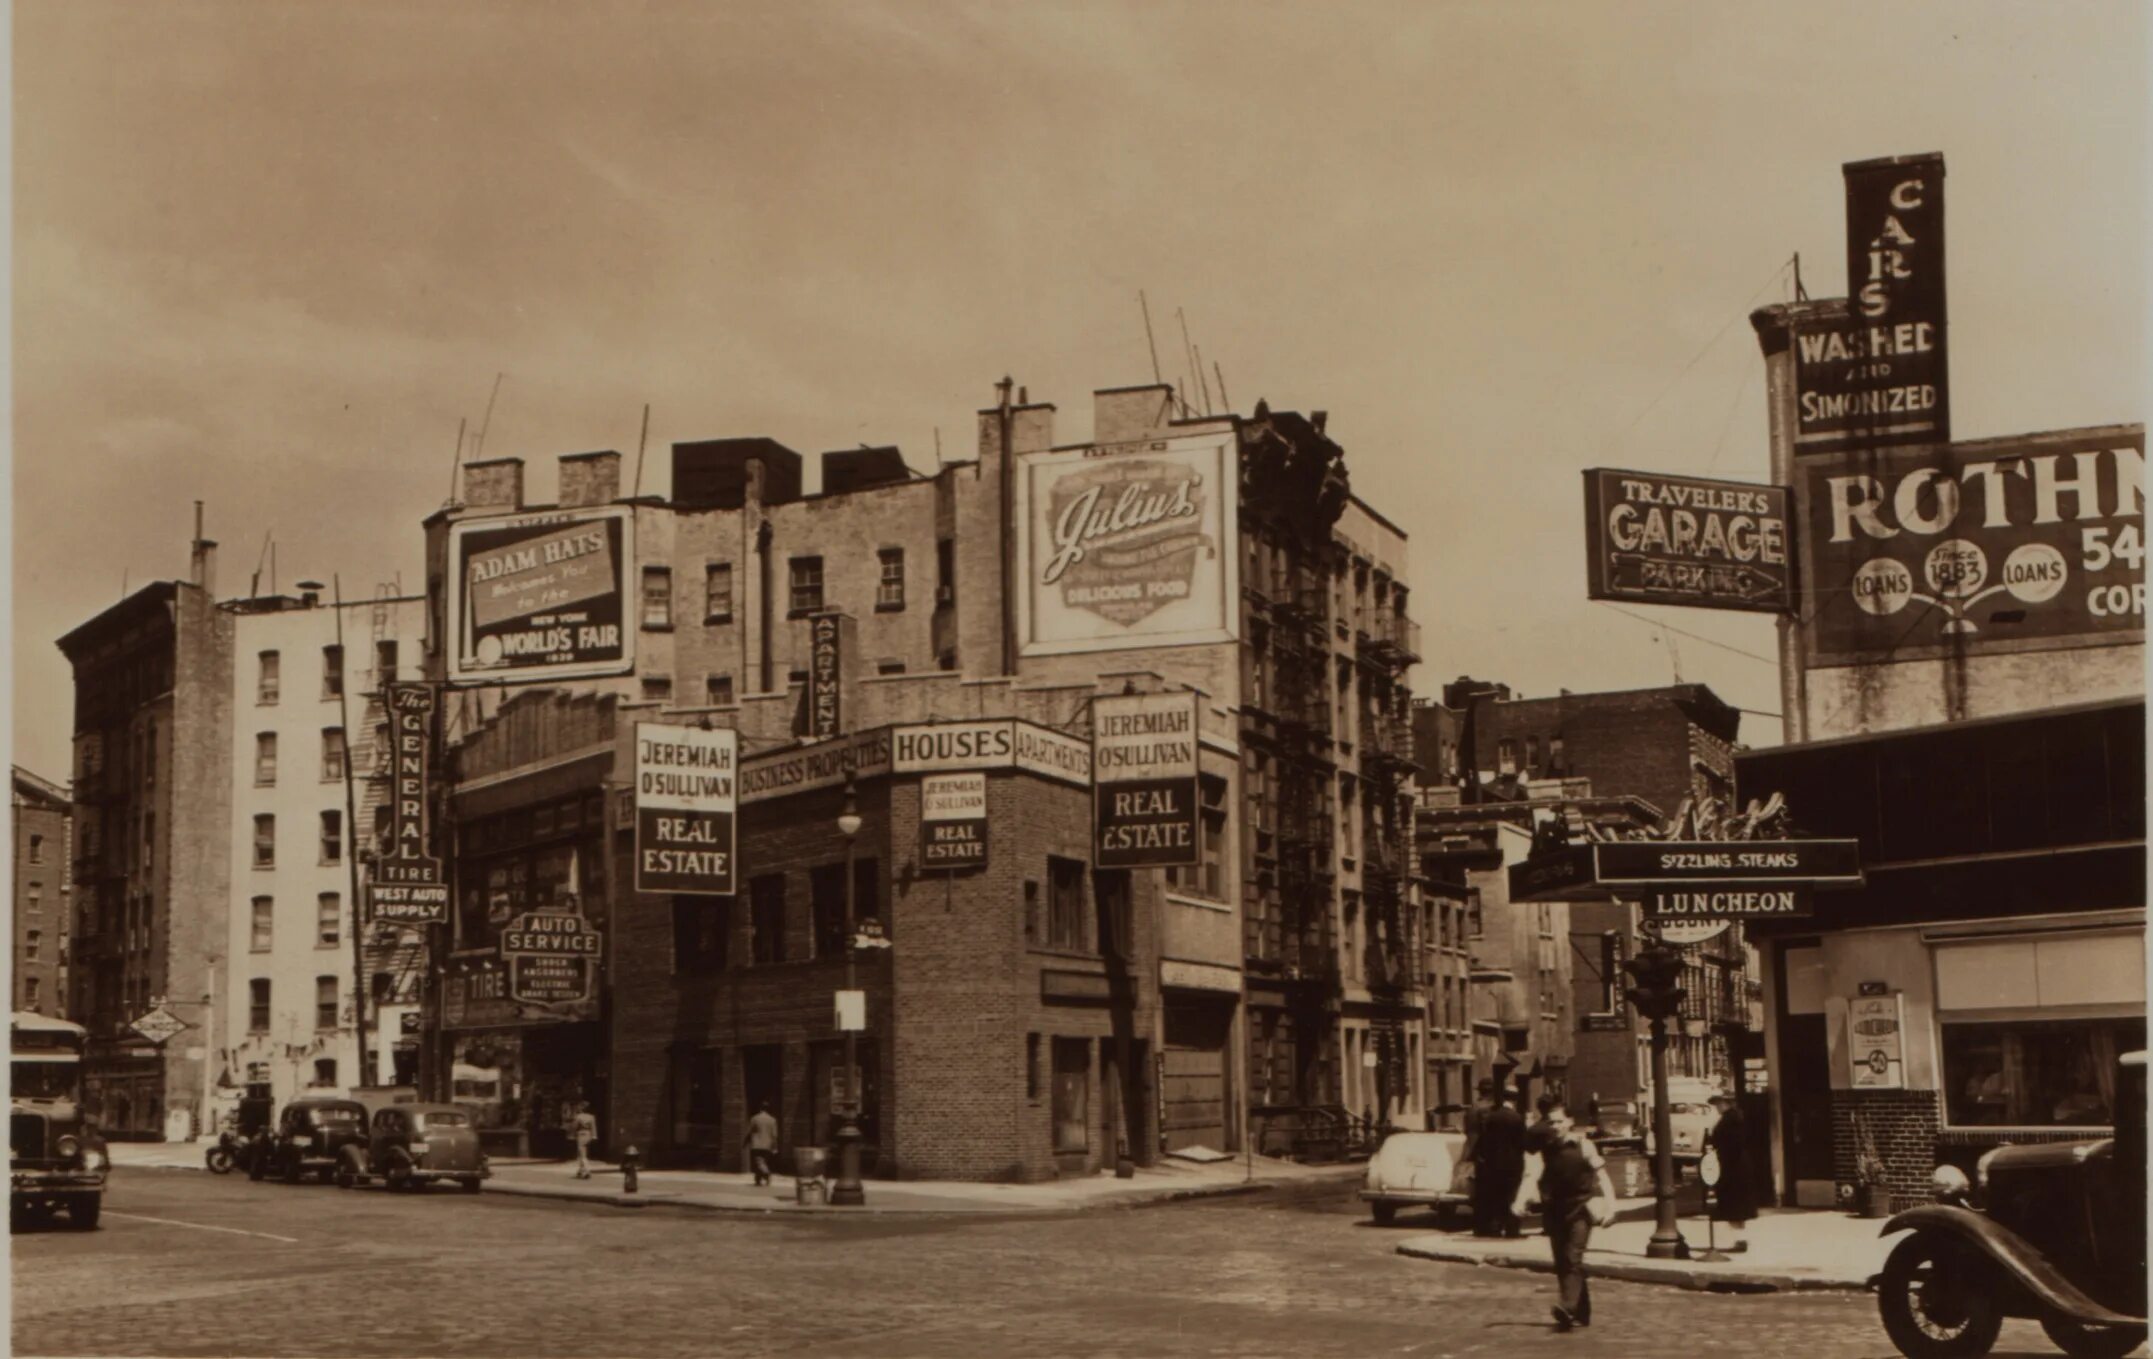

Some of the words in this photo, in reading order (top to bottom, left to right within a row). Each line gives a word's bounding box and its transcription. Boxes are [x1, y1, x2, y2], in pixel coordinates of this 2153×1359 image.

[1859, 179, 1925, 317] CARS
[1799, 321, 1936, 364] WASHED
[1801, 384, 1937, 422] SIMONIZED
[1621, 479, 1770, 514] TRAVELER'S
[1608, 503, 1786, 565] GARAGE
[473, 548, 538, 583] ADAM
[545, 533, 604, 565] HATS
[1855, 573, 1909, 597] LOANS
[1930, 559, 1982, 586] 1883
[2006, 561, 2062, 584] LOANS
[502, 628, 572, 655] WORLD'S
[579, 624, 618, 649] FAIR
[1100, 710, 1189, 737] JEREMIAH
[641, 739, 731, 769] JEREMIAH
[897, 729, 1011, 762] HOUSES
[1017, 731, 1090, 777] APARTMENTS
[402, 714, 421, 860] GENERAL
[742, 758, 803, 795] BUSINESS
[926, 779, 982, 795] JEREMIAH
[1114, 789, 1179, 817] REAL
[656, 817, 717, 844] REAL
[933, 825, 977, 841] REAL
[1103, 822, 1191, 850] ESTATE
[643, 848, 728, 876] ESTATE
[926, 841, 984, 858] ESTATE
[1660, 853, 1732, 869] SIZZLING
[1737, 853, 1799, 869] STEAKS
[386, 866, 432, 881] TIRE
[373, 886, 410, 901] WEST
[412, 886, 447, 901] AUTO
[1656, 891, 1795, 914] LUNCHEON
[375, 903, 441, 917] SUPPLY
[529, 917, 577, 933] AUTO
[509, 933, 596, 952] SERVICE
